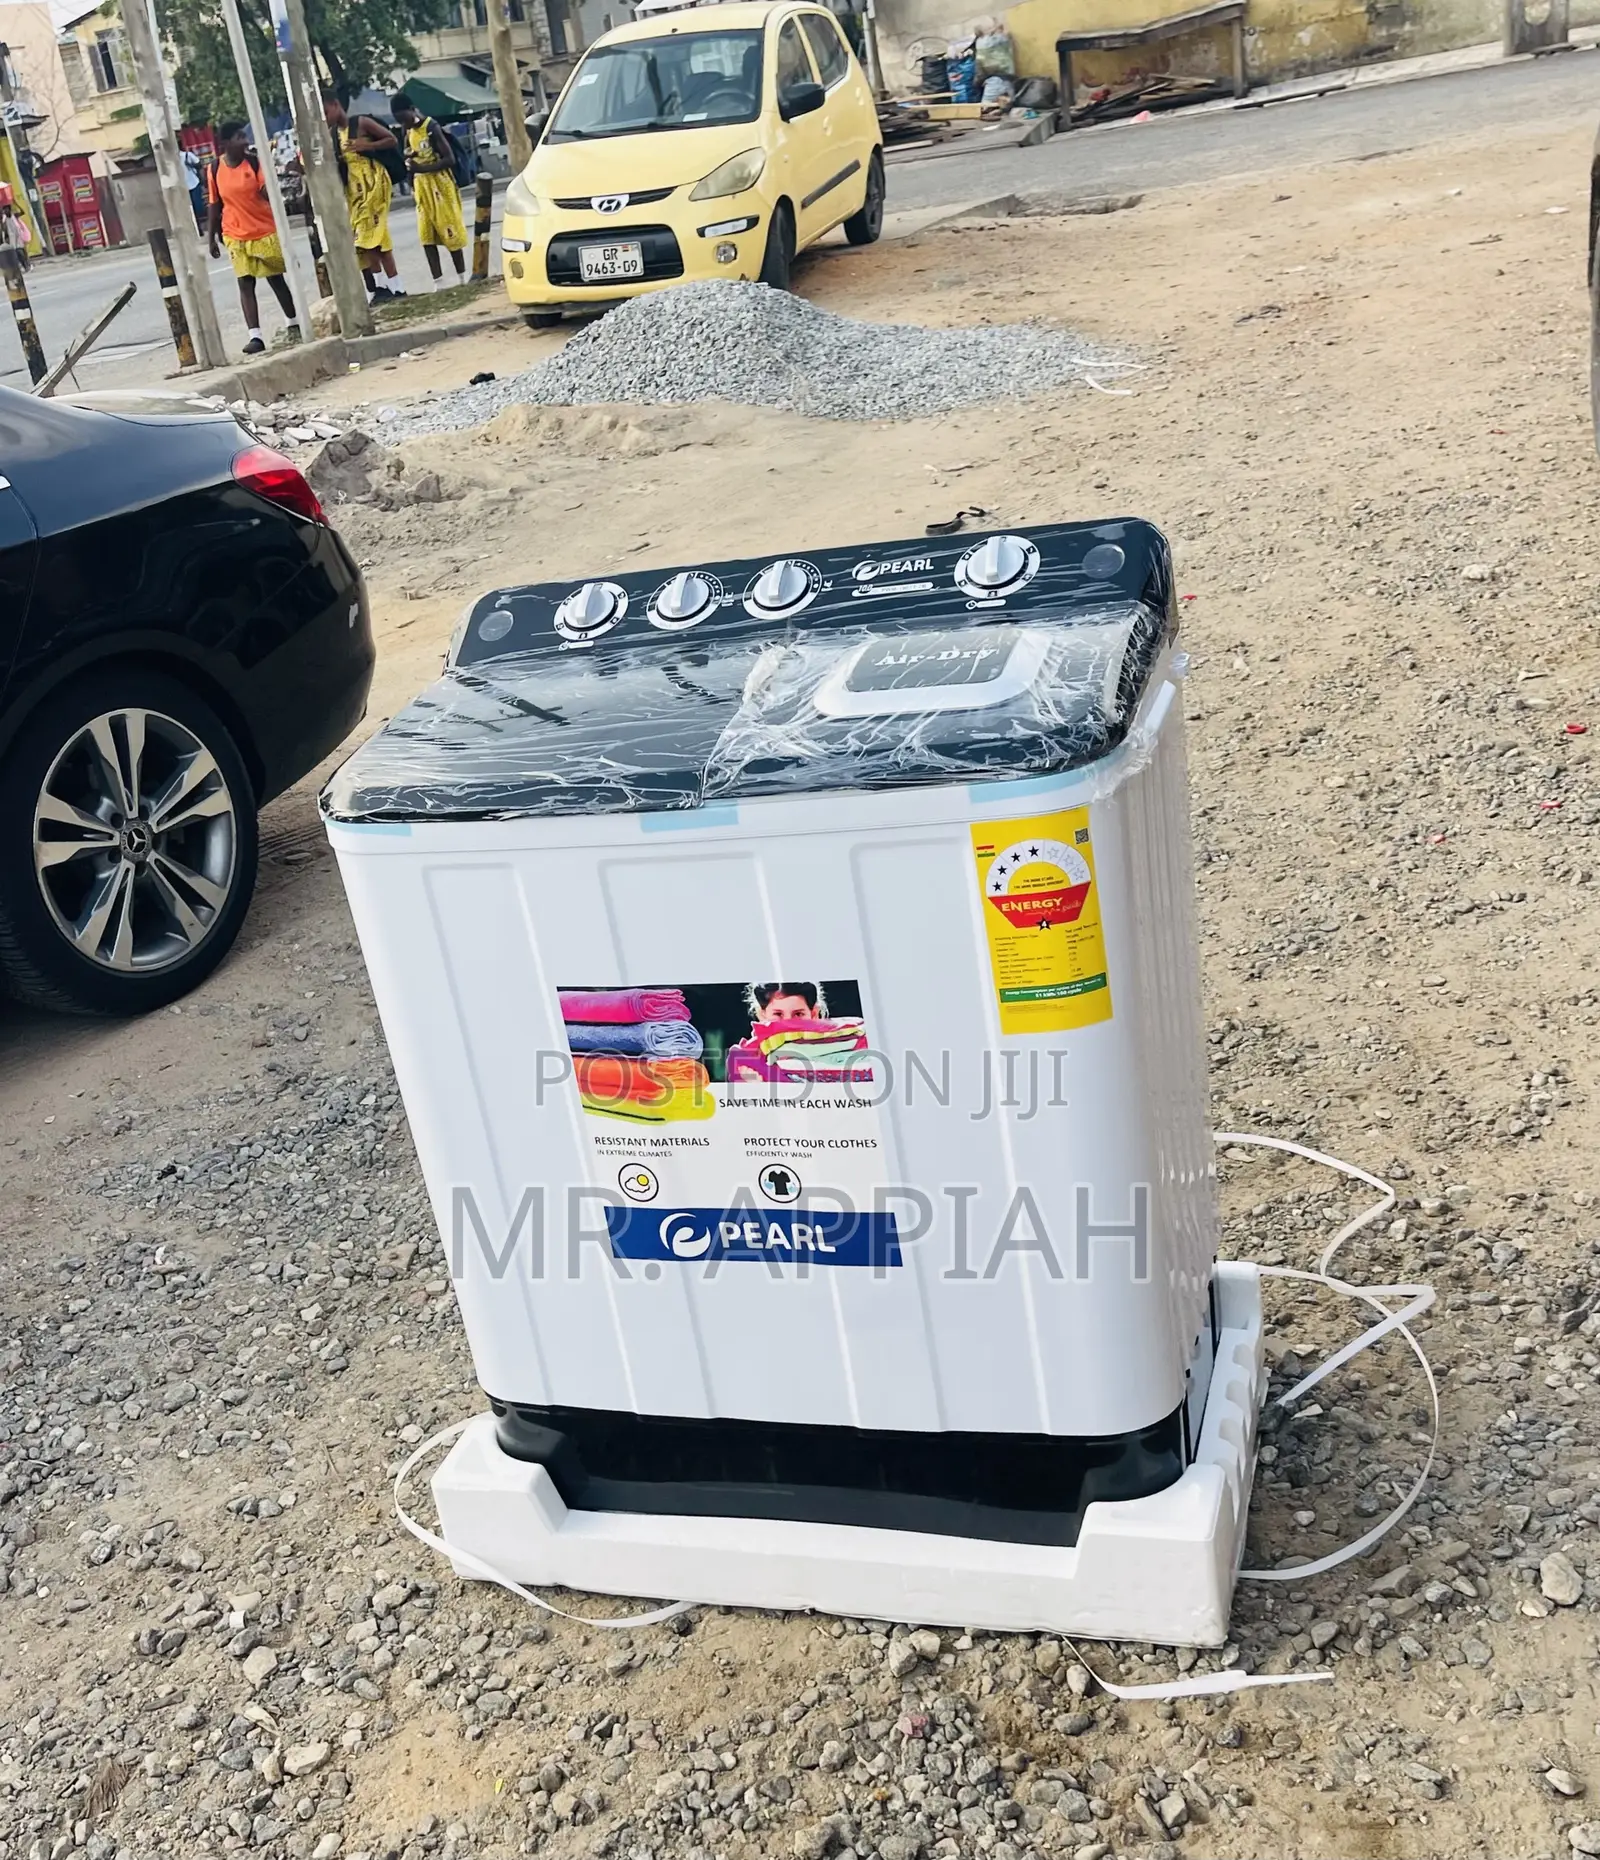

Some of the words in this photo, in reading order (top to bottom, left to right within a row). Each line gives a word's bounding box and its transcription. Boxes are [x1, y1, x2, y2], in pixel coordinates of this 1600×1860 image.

[602, 247, 619, 261] GR
[586, 260, 638, 276] 9463-09
[879, 558, 935, 575] PEARL
[874, 648, 999, 665] Air-Dry
[1001, 897, 1064, 913] ENERGY
[719, 1098, 748, 1109] SAVE
[752, 1098, 781, 1109] TIME
[784, 1098, 797, 1109] IN
[800, 1098, 831, 1109] EACH
[835, 1098, 872, 1109] WASH
[594, 1136, 647, 1147] RESISTANT
[650, 1137, 710, 1147] MATERIALS
[744, 1137, 791, 1147] PROTECT
[793, 1138, 826, 1148] YOUR
[827, 1139, 878, 1149] CLOTHES
[638, 1150, 673, 1158] CLIMATES
[746, 1150, 789, 1158] EFFICIENTLY
[718, 1221, 837, 1253] PEARL
